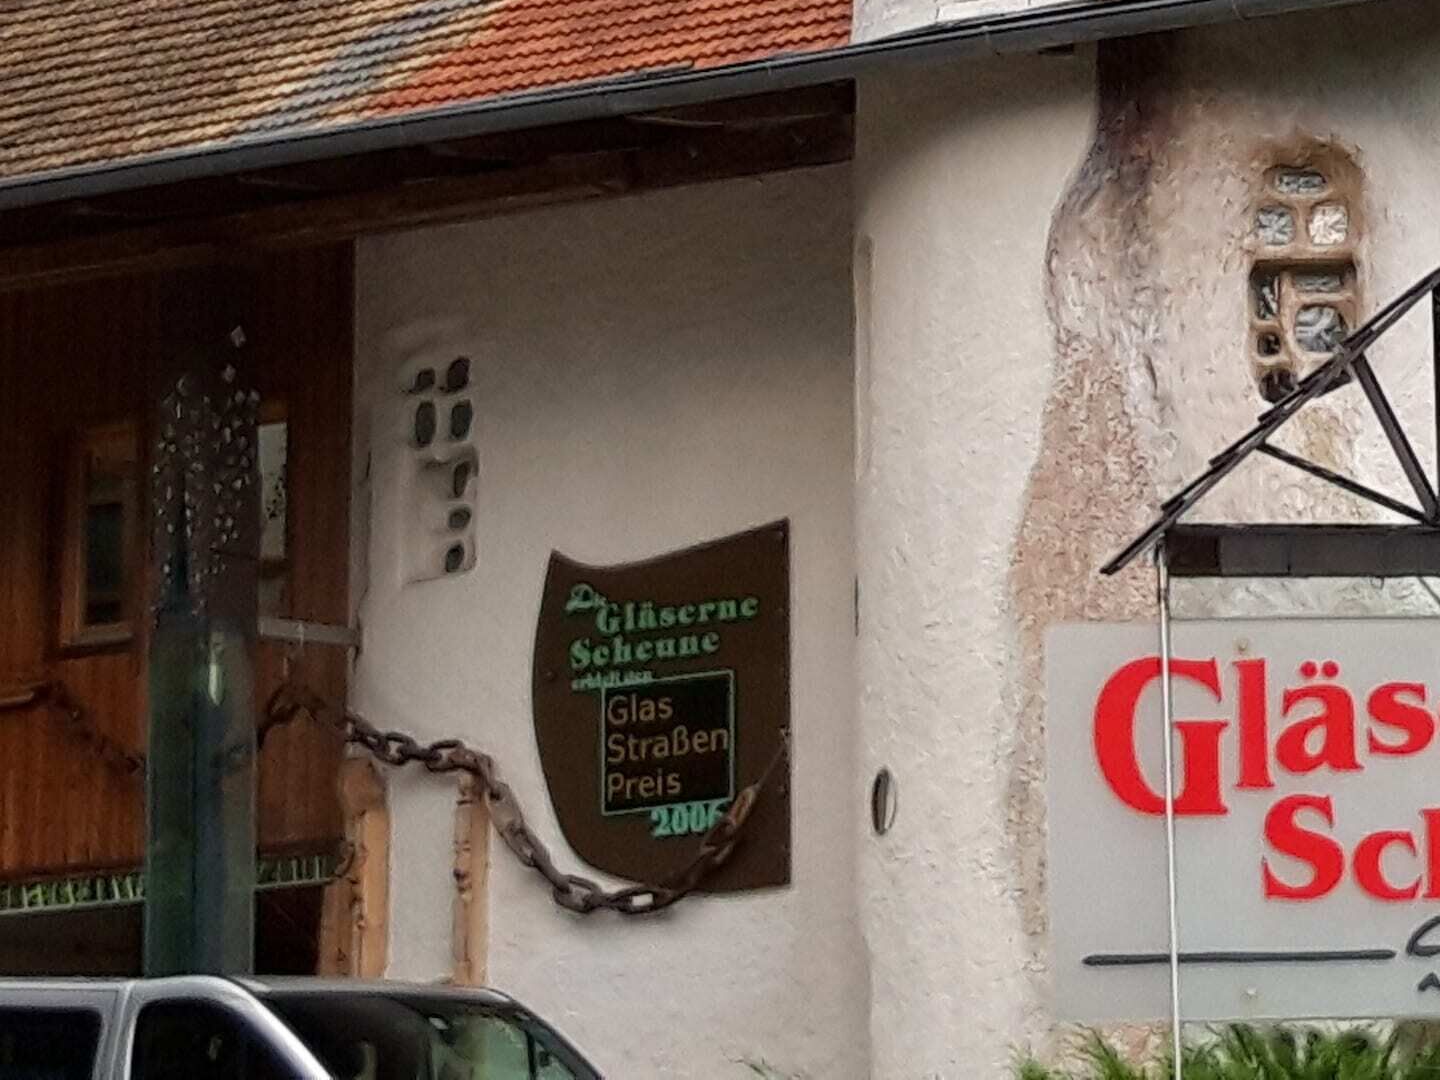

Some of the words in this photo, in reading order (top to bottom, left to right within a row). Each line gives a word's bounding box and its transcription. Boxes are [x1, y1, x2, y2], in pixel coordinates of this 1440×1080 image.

[597, 597, 760, 633] Gläserne
[570, 631, 721, 670] Scheune
[607, 695, 673, 724] Glas
[607, 726, 729, 764] Straßen
[607, 770, 682, 803] Preis
